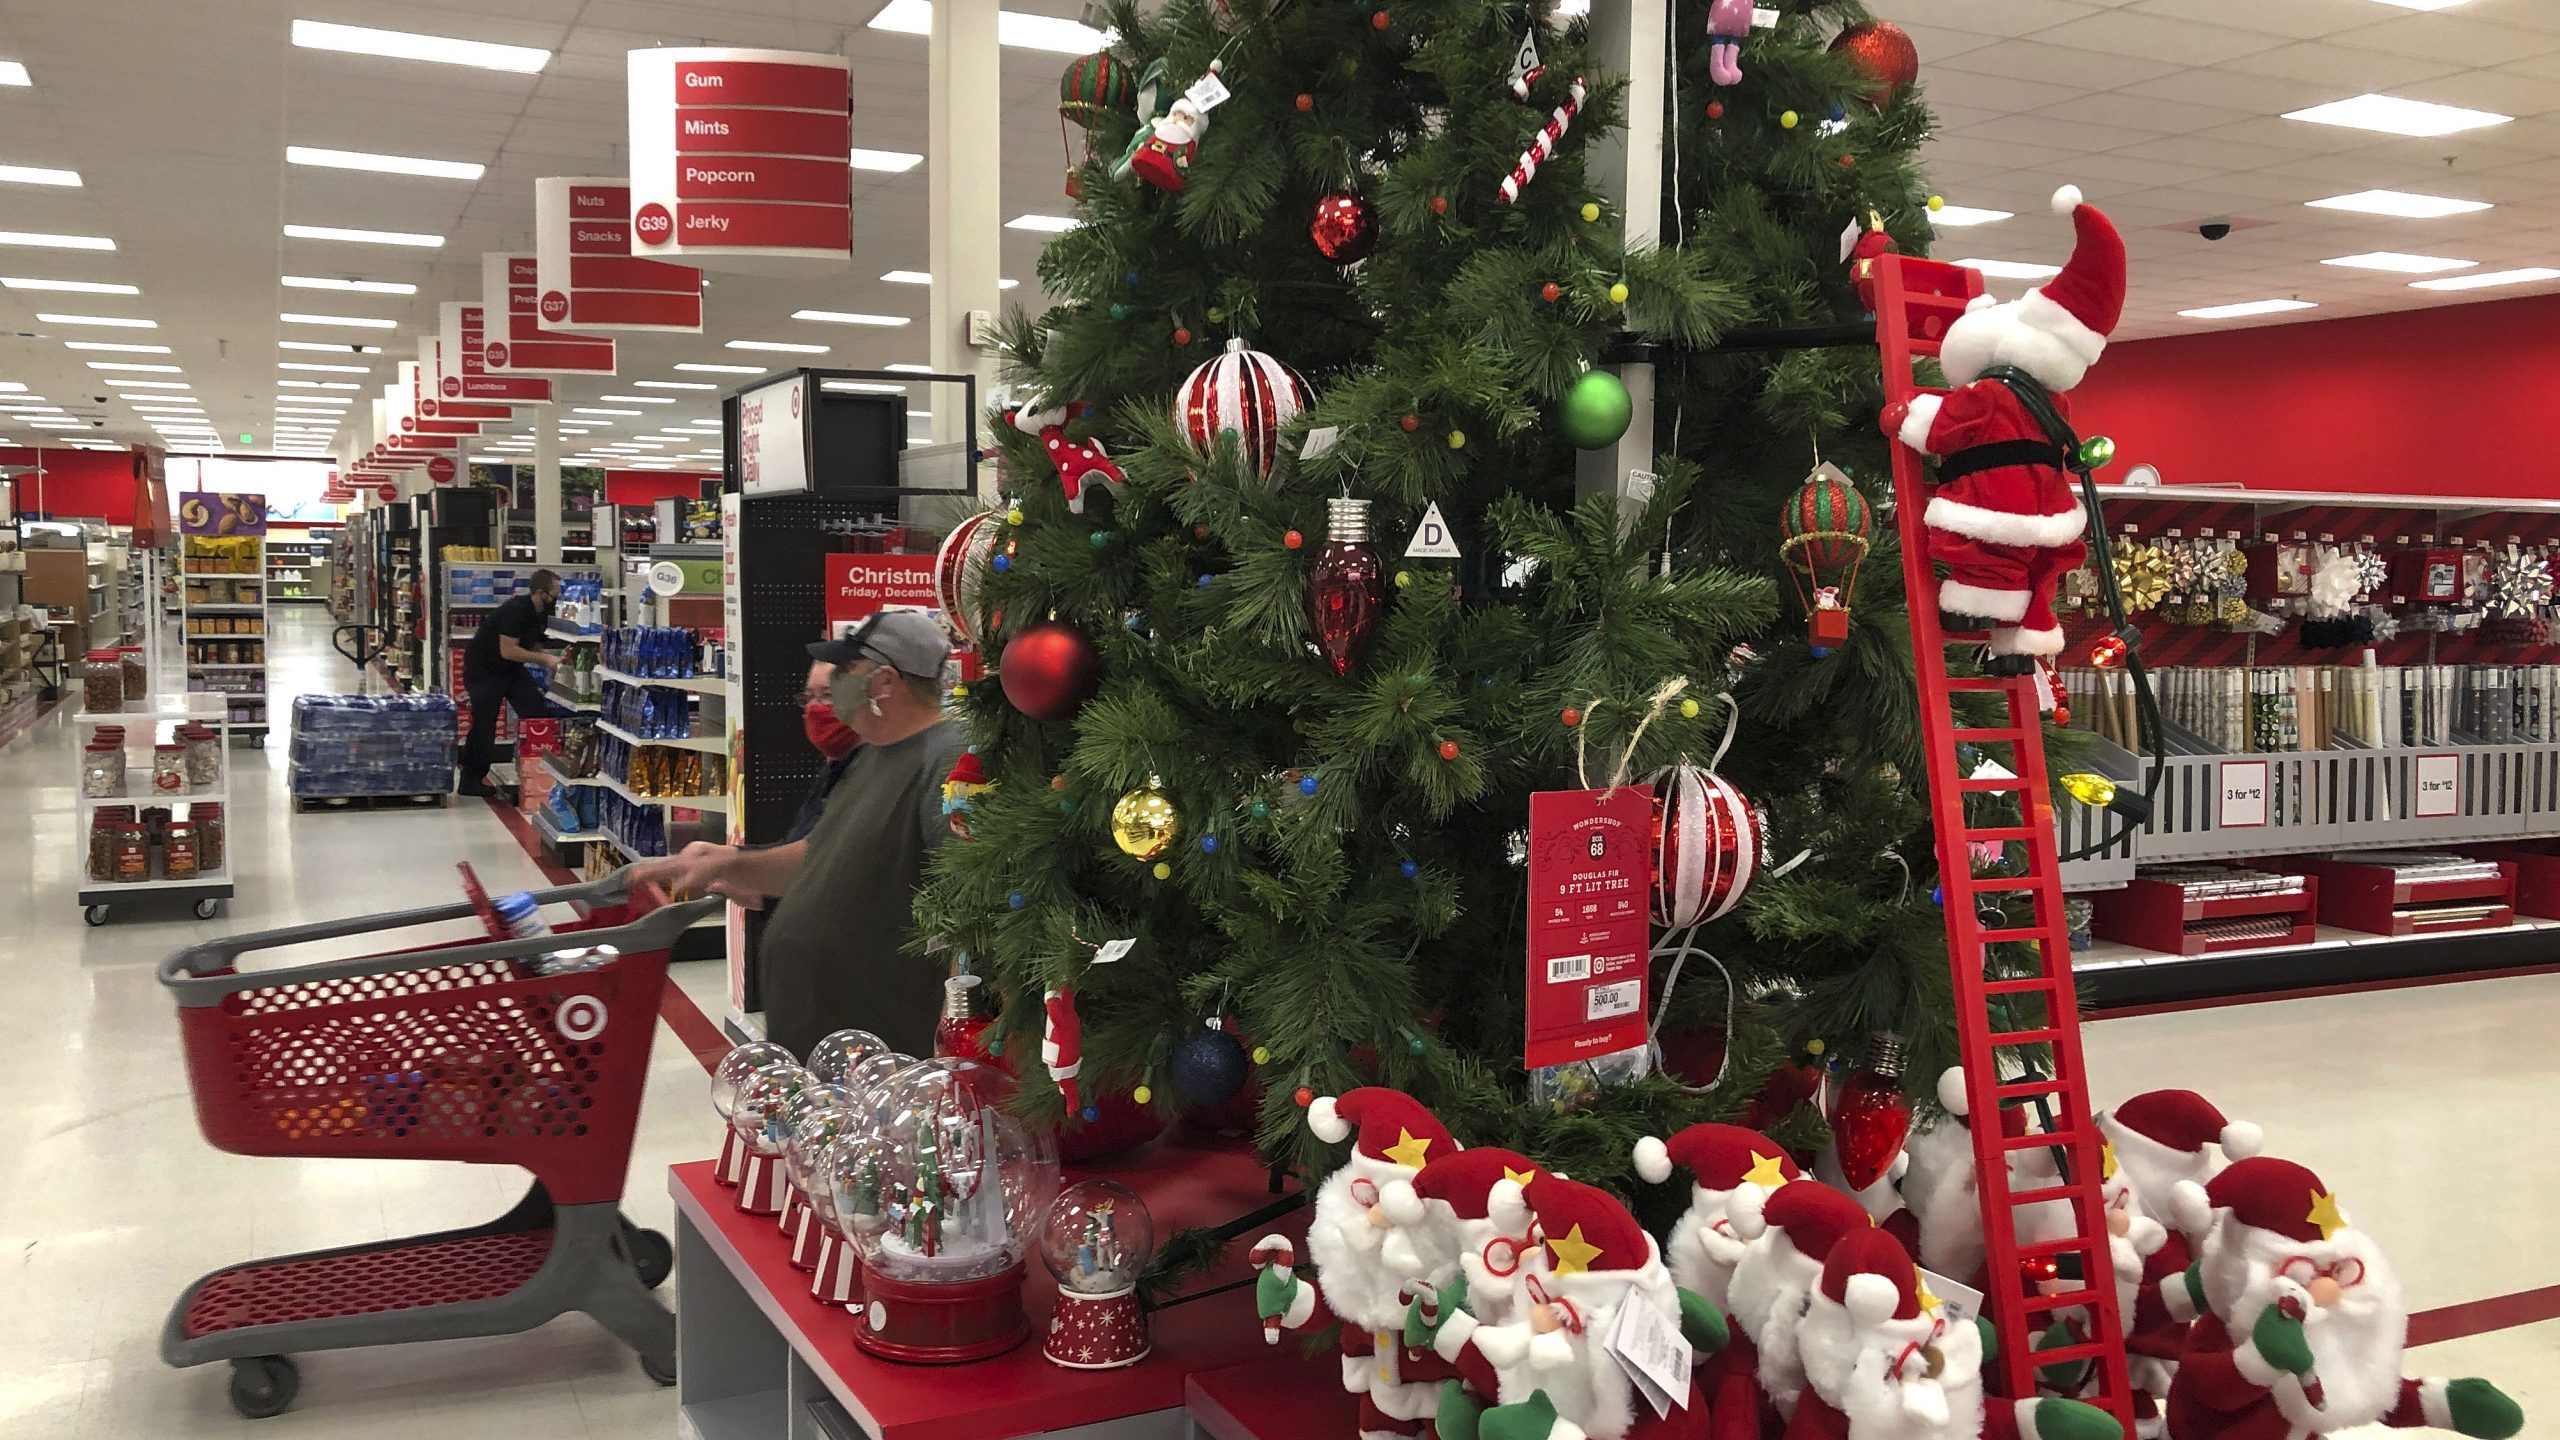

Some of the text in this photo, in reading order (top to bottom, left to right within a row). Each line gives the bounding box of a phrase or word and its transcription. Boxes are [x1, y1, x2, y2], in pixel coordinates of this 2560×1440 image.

[1521, 47, 1533, 69] C
[685, 72, 723, 87] Gum
[685, 120, 730, 135] Mints
[685, 167, 755, 184] Popcorn
[577, 195, 605, 206] Nuts
[639, 216, 668, 231] G39
[685, 214, 730, 232] Jerky
[577, 231, 622, 242] Snacks
[514, 265, 537, 275] Chip
[543, 301, 565, 312] G37
[467, 382, 507, 390] Lunchbox
[1424, 523, 1443, 546] D
[841, 586, 882, 599] Friday,
[2422, 781, 2428, 791] 3
[2429, 781, 2441, 791] for
[2227, 789, 2233, 800] 3
[2235, 788, 2247, 800] for
[1572, 816, 1622, 831] WONDERSHOP
[1590, 842, 1604, 856] 68
[1572, 869, 1619, 881] DOUGLAS FIR
[1560, 878, 1629, 895] 9 FT LIT TREE
[1594, 992, 1619, 1006] 500.00
